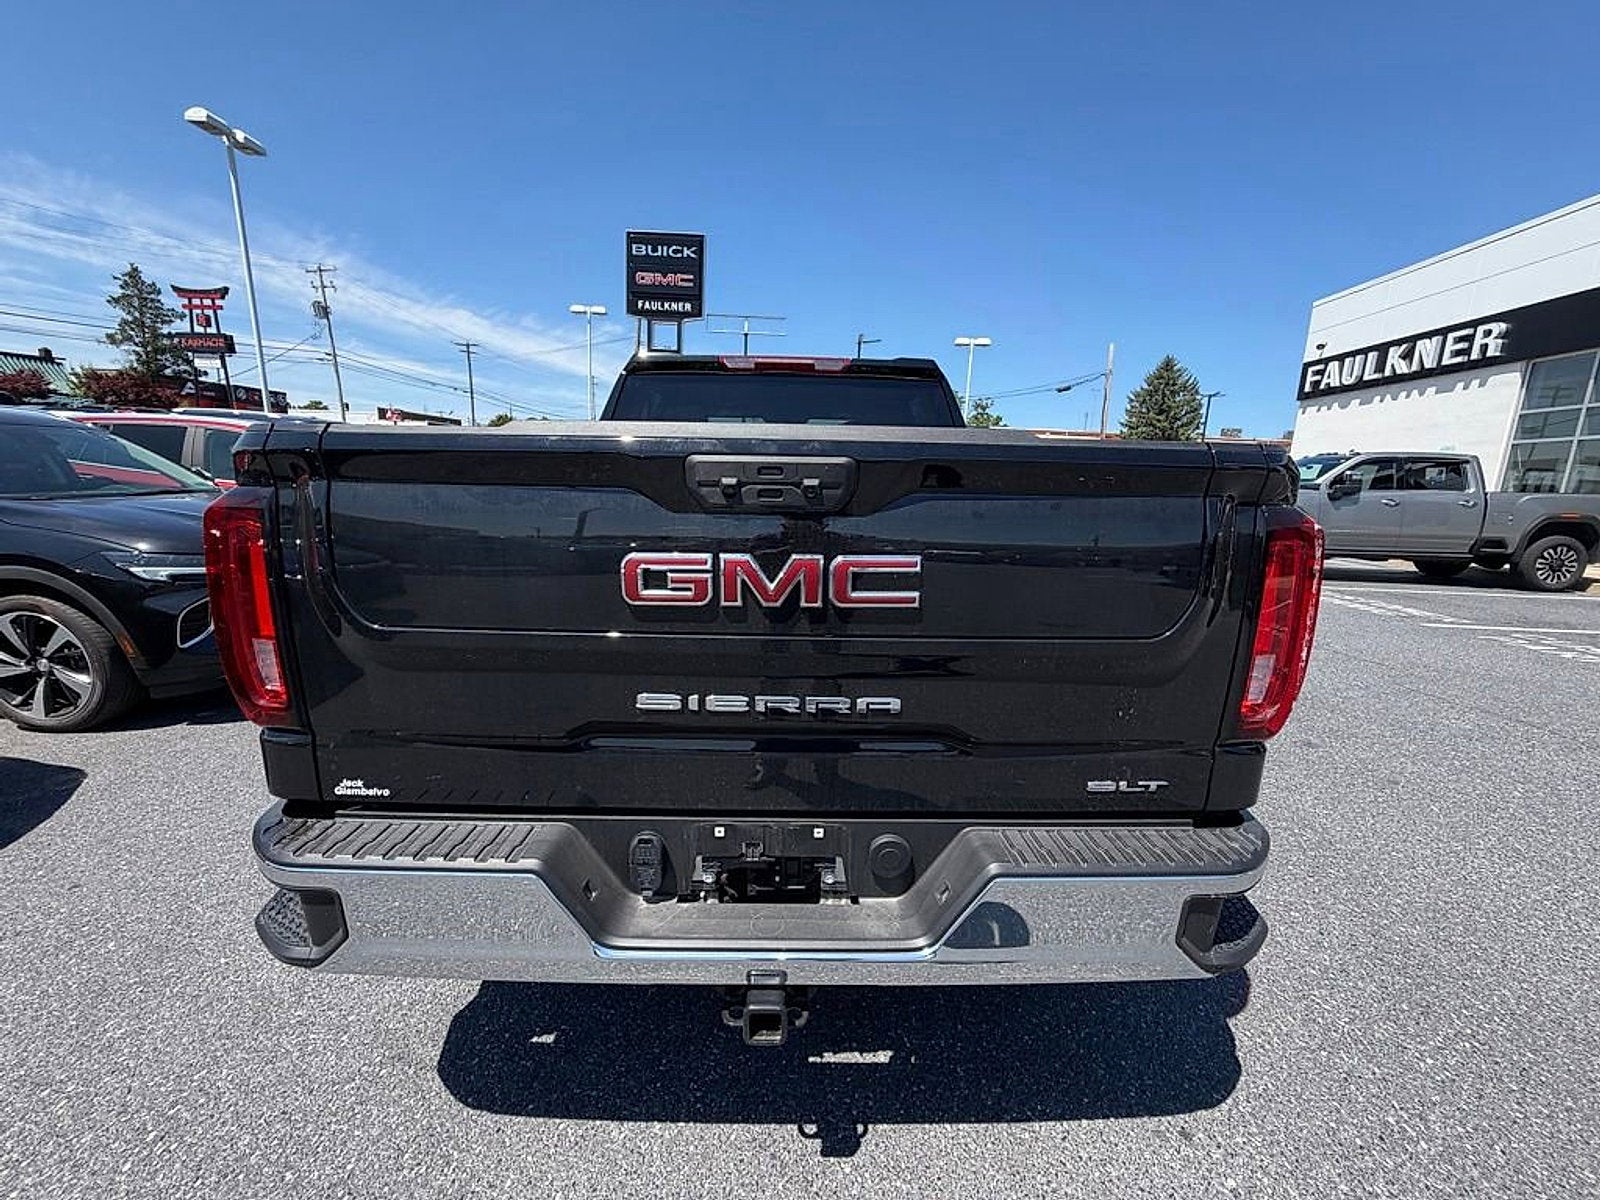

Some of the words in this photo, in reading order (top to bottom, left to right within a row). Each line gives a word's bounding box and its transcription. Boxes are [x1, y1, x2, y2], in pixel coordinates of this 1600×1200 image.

[632, 244, 698, 258] BUICK
[635, 271, 694, 287] GMC
[637, 300, 692, 312] FAULKNER
[1303, 322, 1508, 393] FAULKNER
[620, 552, 922, 608] GMC
[636, 693, 902, 714] SIERRA
[339, 778, 364, 787] Jack
[1086, 780, 1169, 792] SLT
